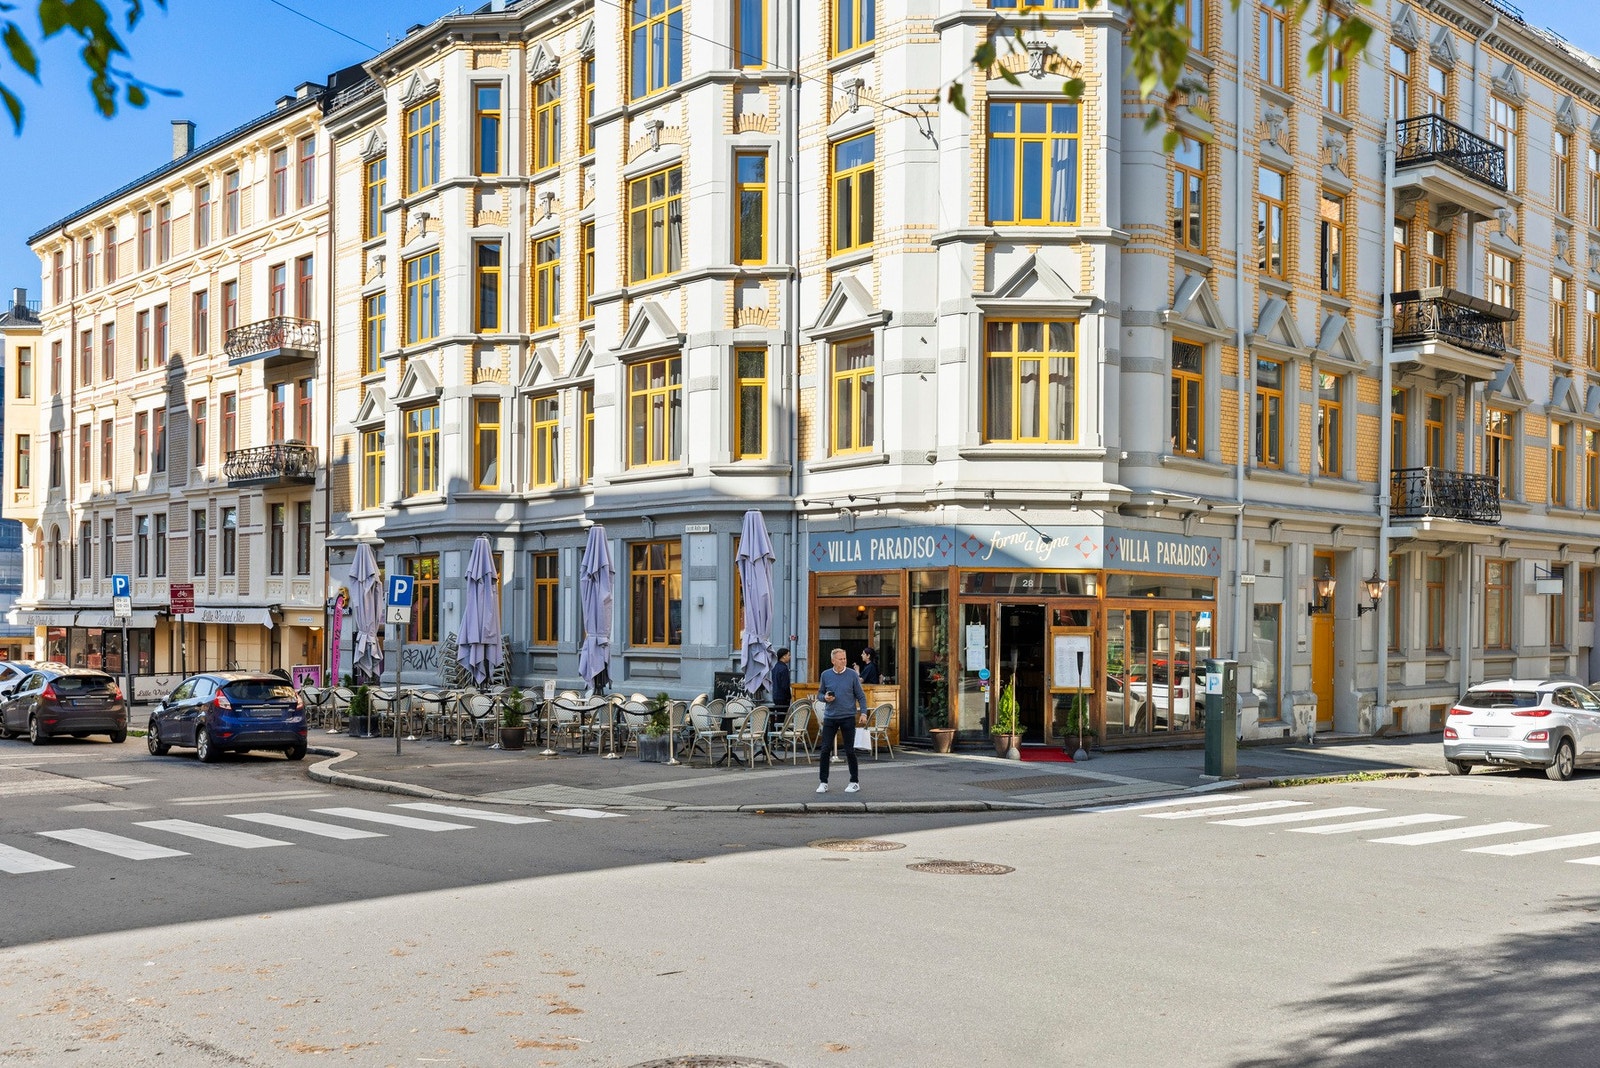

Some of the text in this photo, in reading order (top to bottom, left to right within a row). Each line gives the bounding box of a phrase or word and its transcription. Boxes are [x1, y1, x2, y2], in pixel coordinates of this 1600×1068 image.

[828, 535, 936, 563] VILLA PARADISO
[982, 530, 1070, 562] forno a legna
[1119, 537, 1208, 567] VILLA PARADISO
[116, 577, 126, 594] P
[394, 579, 408, 602] P
[1022, 579, 1034, 587] 28
[1209, 676, 1220, 691] P
